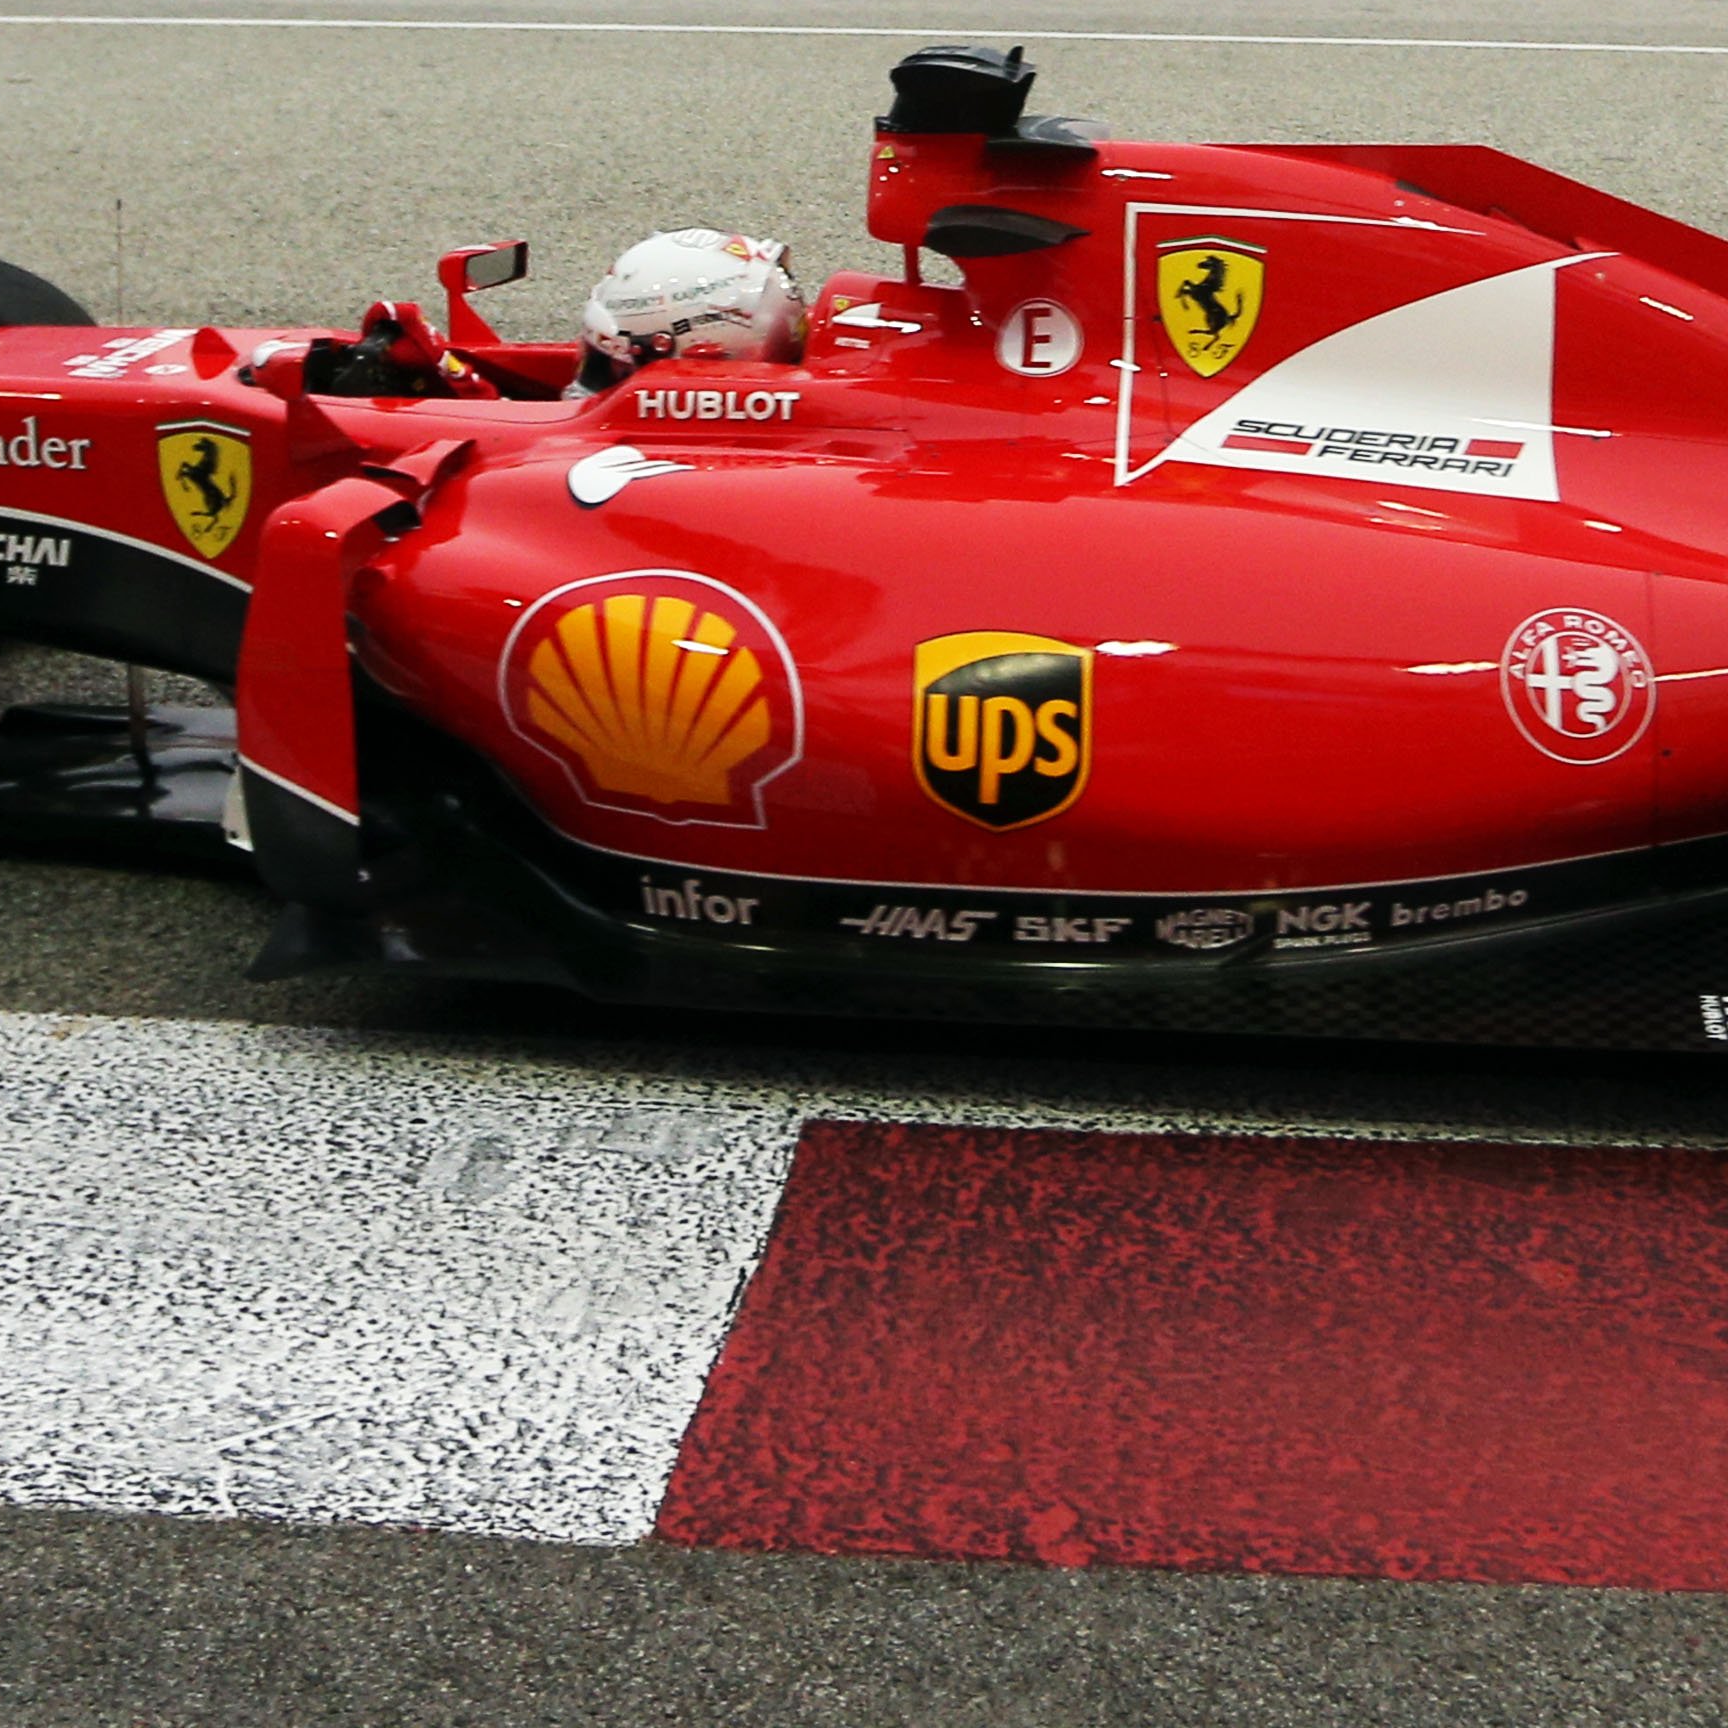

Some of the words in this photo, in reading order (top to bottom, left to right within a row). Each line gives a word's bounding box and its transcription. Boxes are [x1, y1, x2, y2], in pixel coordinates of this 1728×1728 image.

[1021, 307, 1052, 368] E
[634, 390, 800, 420] HUBLOT
[1231, 419, 1460, 454] SCUDERIA
[1317, 444, 1513, 478] FERRARI
[1508, 622, 1556, 680] ALFA
[1563, 615, 1647, 689] ROMEO
[925, 694, 1079, 805] ups
[641, 876, 759, 926] infor
[840, 906, 997, 941] HAAS
[1013, 916, 1132, 942] SKF
[1277, 902, 1372, 934] NGK
[1391, 890, 1529, 926] brembo
[1699, 995, 1728, 1040] HUBLOT
